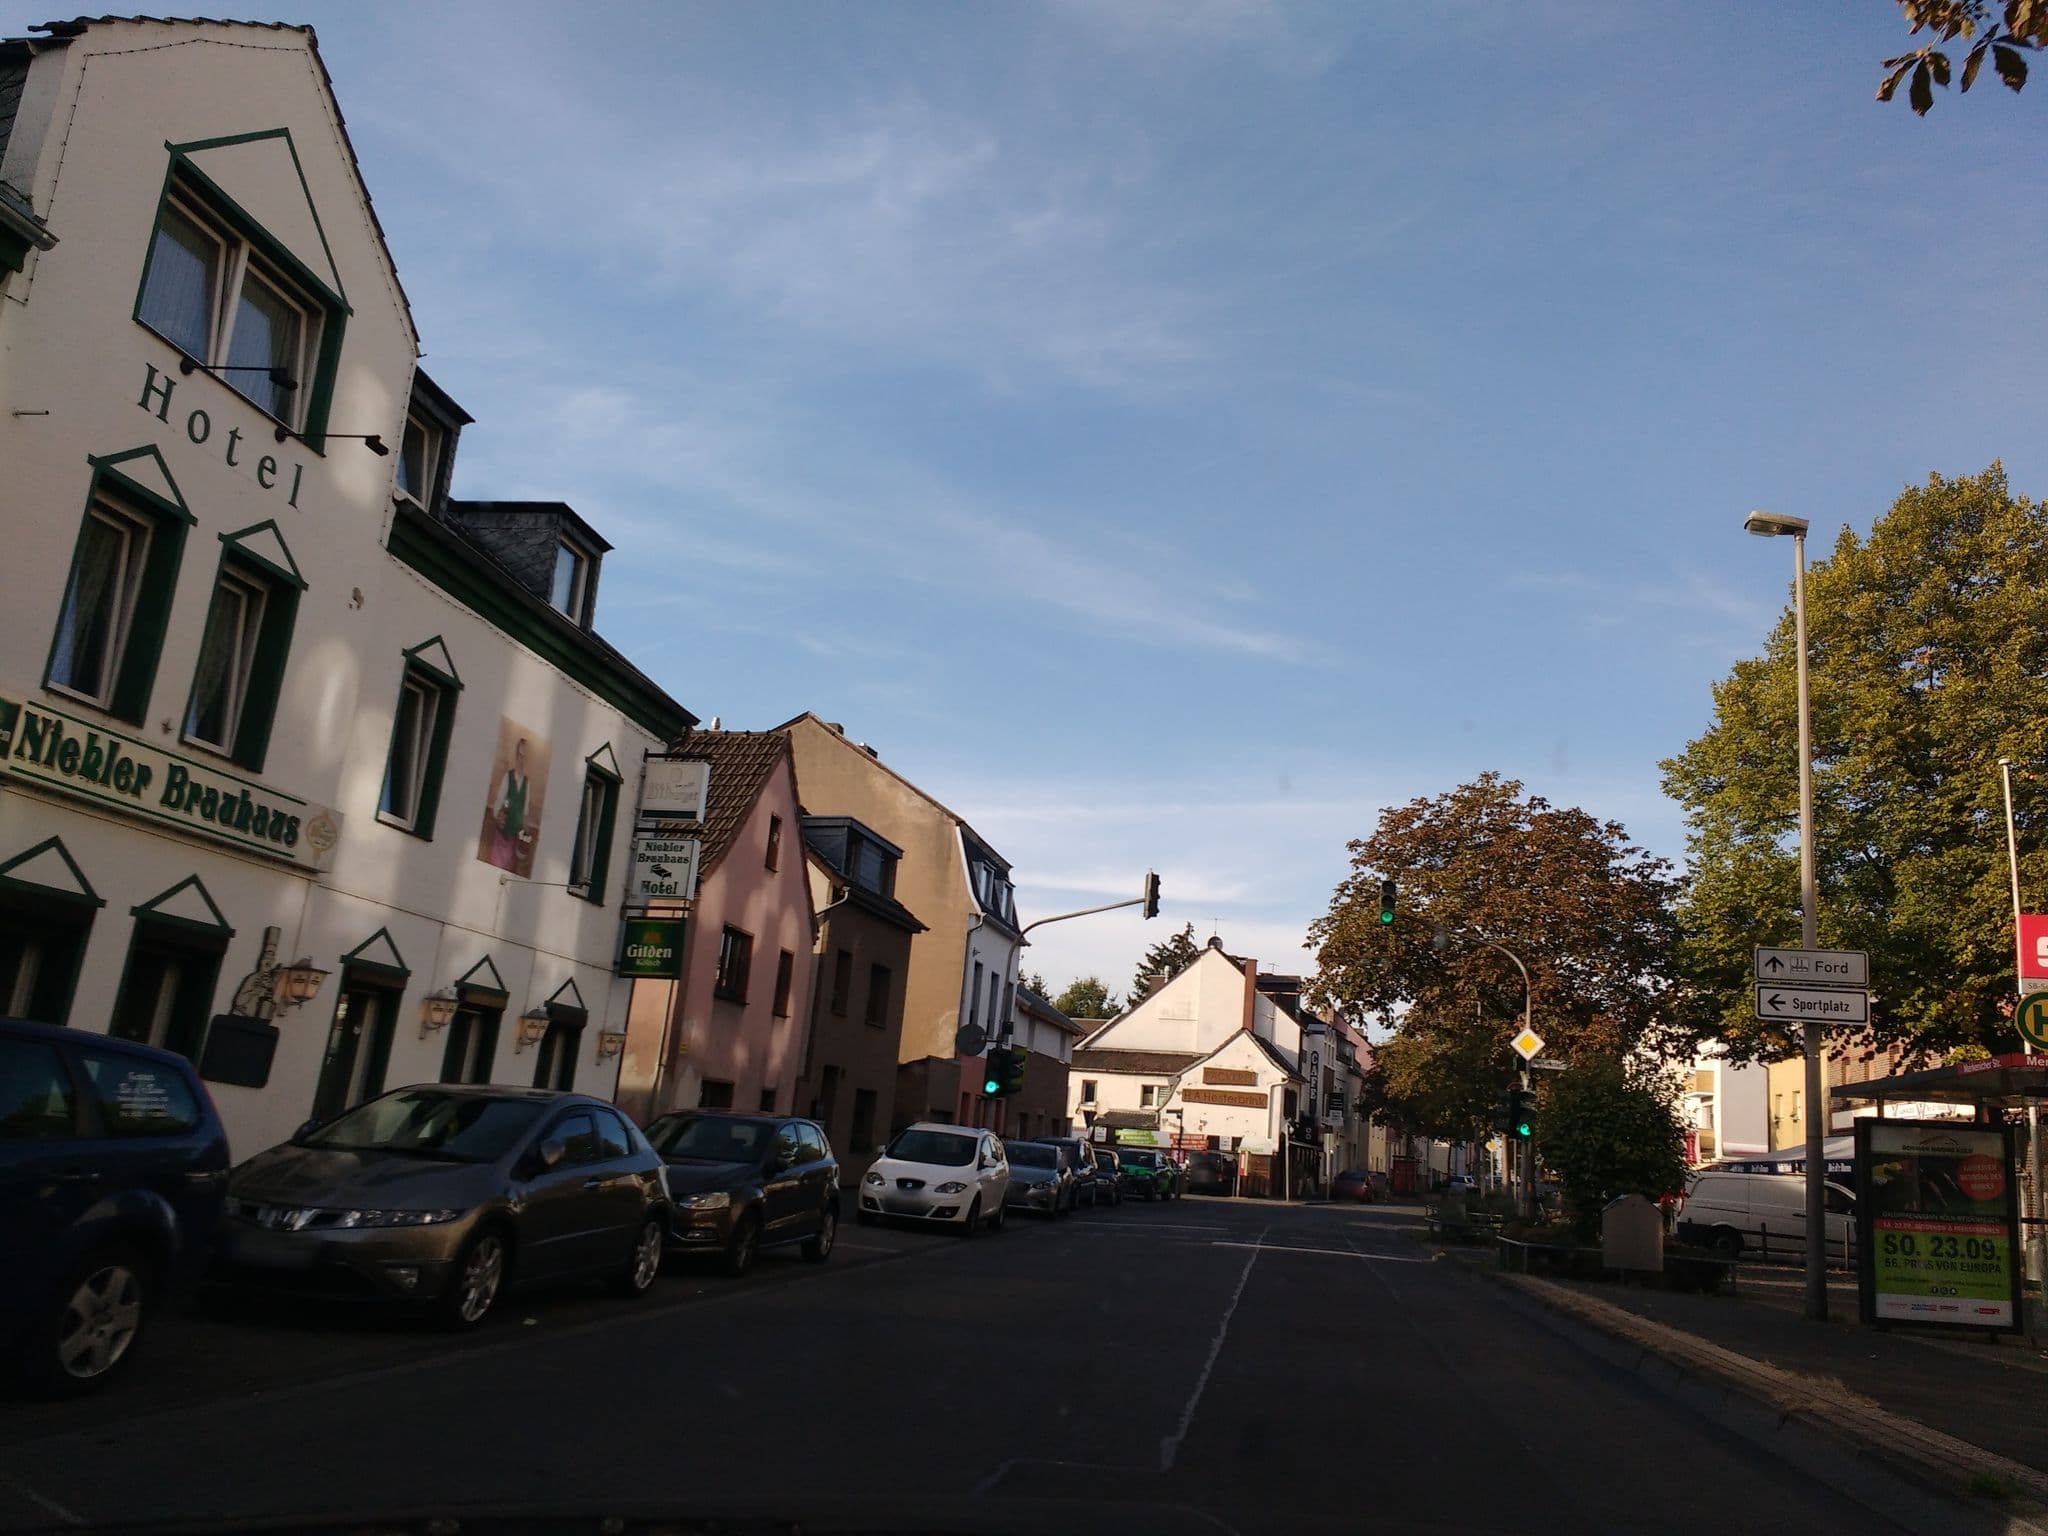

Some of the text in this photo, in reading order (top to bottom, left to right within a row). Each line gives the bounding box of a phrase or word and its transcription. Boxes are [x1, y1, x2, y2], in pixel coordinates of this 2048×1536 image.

[137, 362, 304, 510] Hotel
[14, 710, 302, 849] Niehler Brauhaus
[644, 842, 685, 853] Niehler
[636, 853, 690, 865] Brauhaus
[640, 880, 679, 895] Hotel
[626, 944, 673, 959] Gilden
[1815, 960, 1849, 975] Ford
[1792, 997, 1850, 1014] Sportplatz
[1884, 1233, 2001, 1261] SO. 23.09.
[1960, 1263, 2001, 1275] EUROPA
